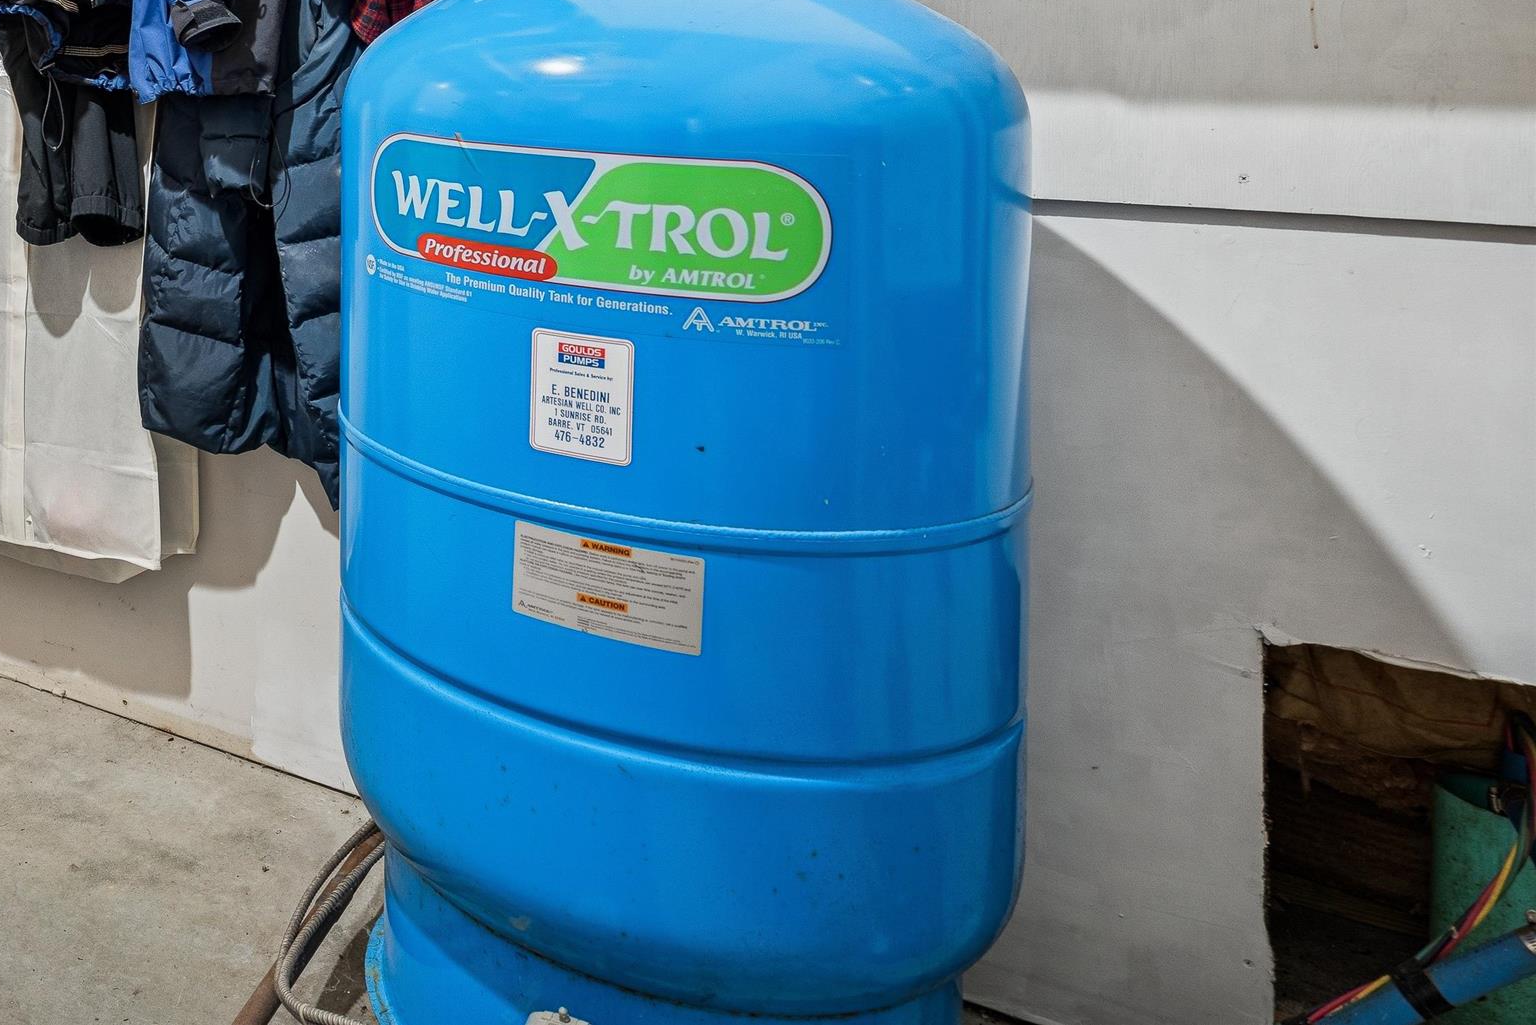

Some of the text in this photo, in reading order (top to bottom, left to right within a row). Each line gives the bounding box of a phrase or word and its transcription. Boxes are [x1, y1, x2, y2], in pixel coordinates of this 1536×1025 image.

[424, 238, 547, 275] Professional
[628, 265, 757, 289] by AMTROL
[445, 272, 673, 316] The Premium Quality Tank for Generations.
[718, 316, 817, 332] AMTROL
[788, 332, 803, 340] USA
[562, 344, 602, 357] GOULDS
[563, 356, 599, 367] PUMPS
[551, 383, 610, 404] E. BENEDINI
[541, 395, 621, 416] ARTESIAN WELL CO. INC
[560, 409, 592, 422] SUNRISE
[576, 422, 585, 432] VT
[590, 424, 613, 436] 05641
[554, 430, 605, 449] 476-4832
[590, 542, 631, 557] WARNING
[588, 597, 626, 611] CAUTION
